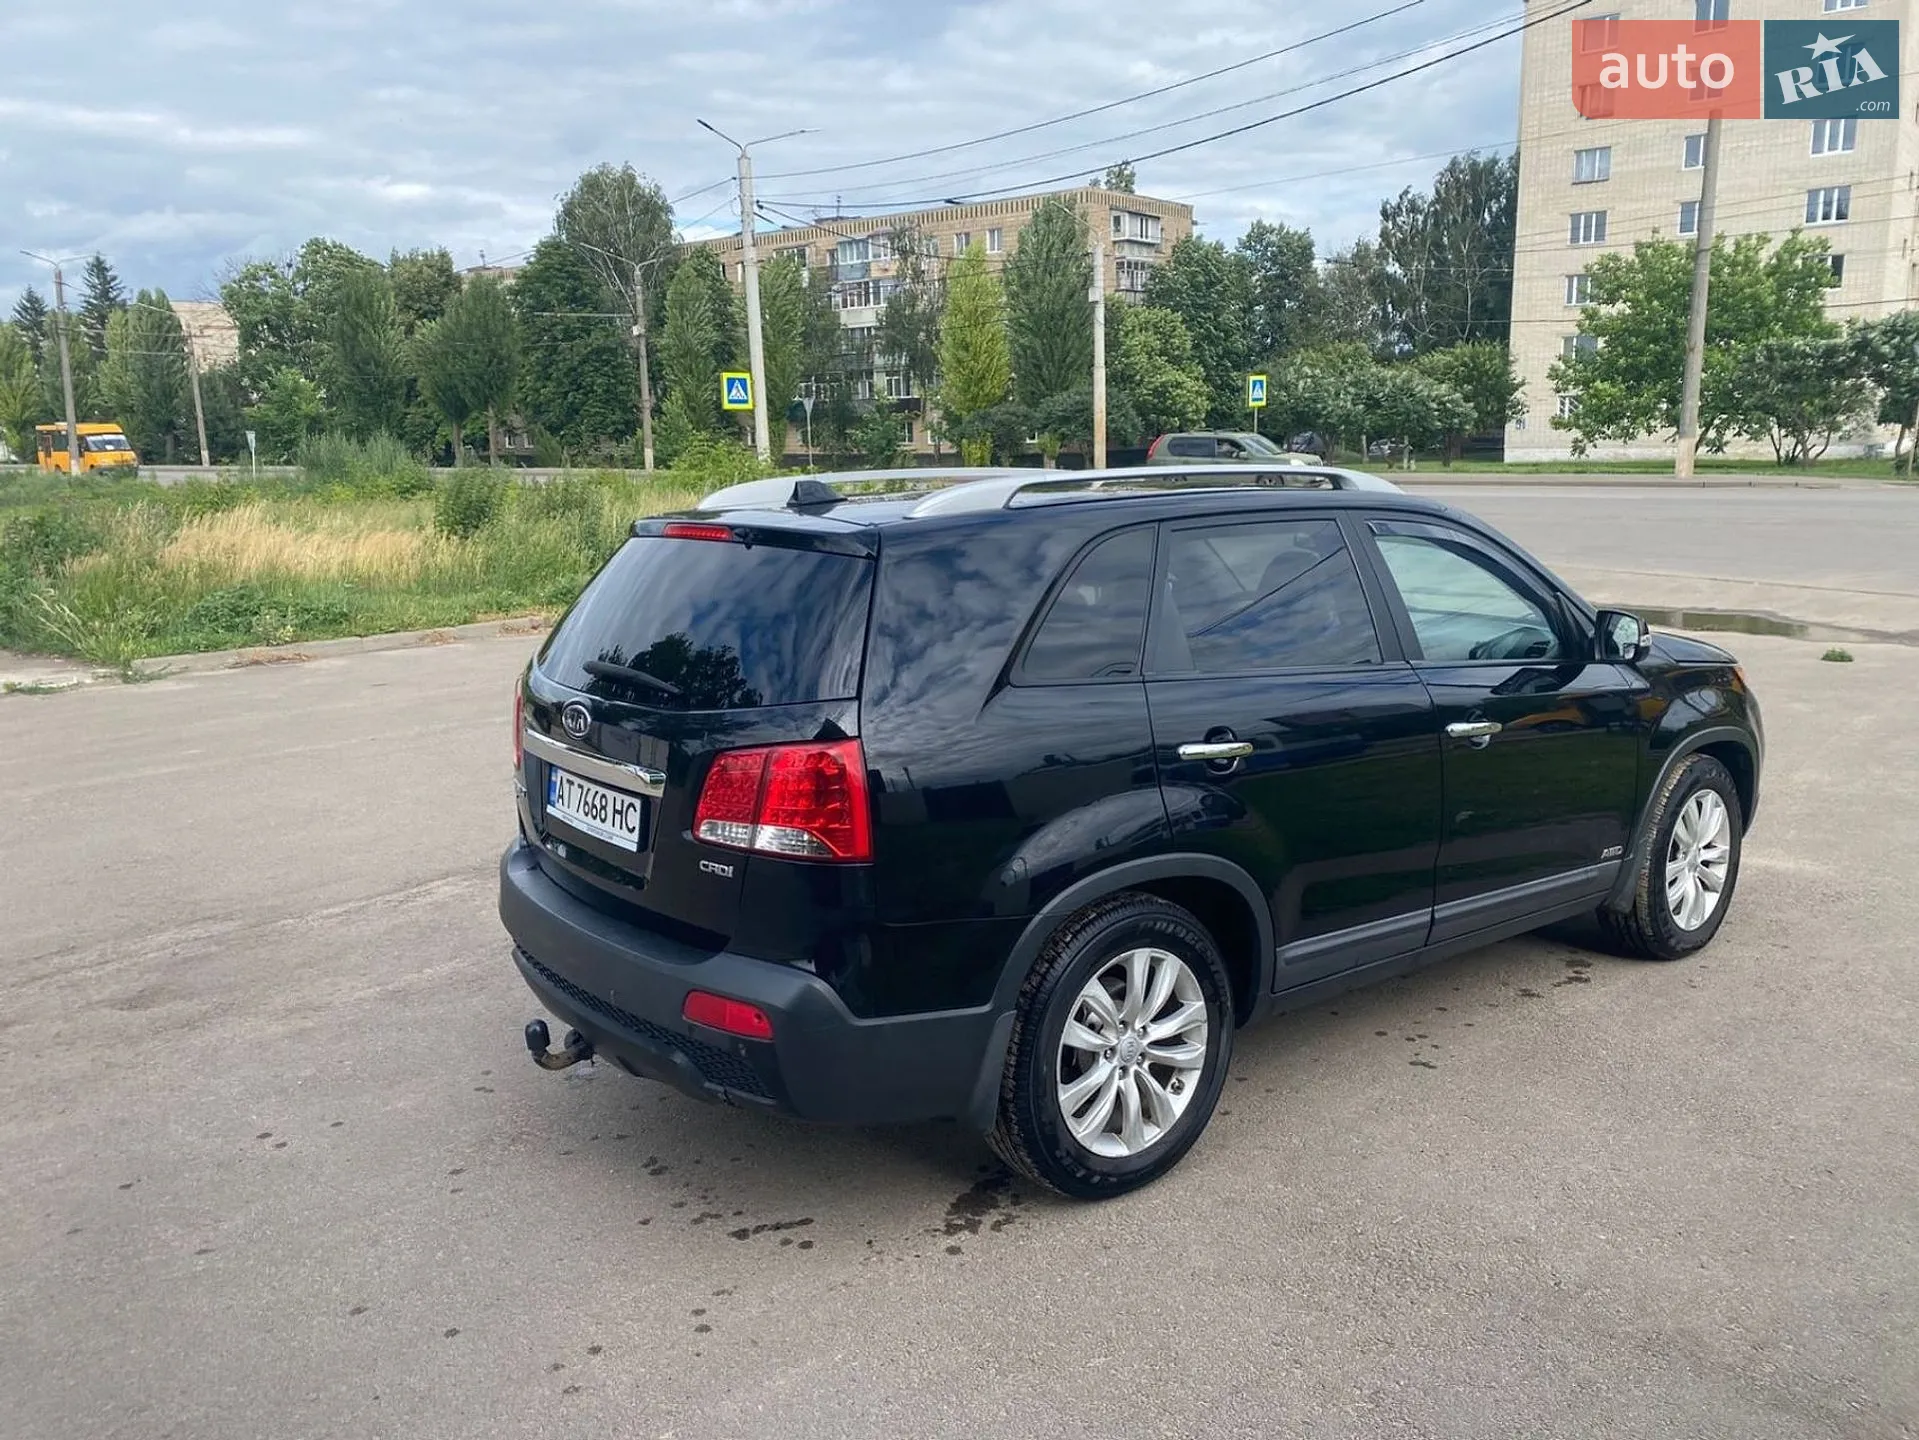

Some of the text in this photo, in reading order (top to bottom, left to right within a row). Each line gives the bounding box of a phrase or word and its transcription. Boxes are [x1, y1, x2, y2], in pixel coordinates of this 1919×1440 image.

[557, 775, 638, 834] AT 7668 HC
